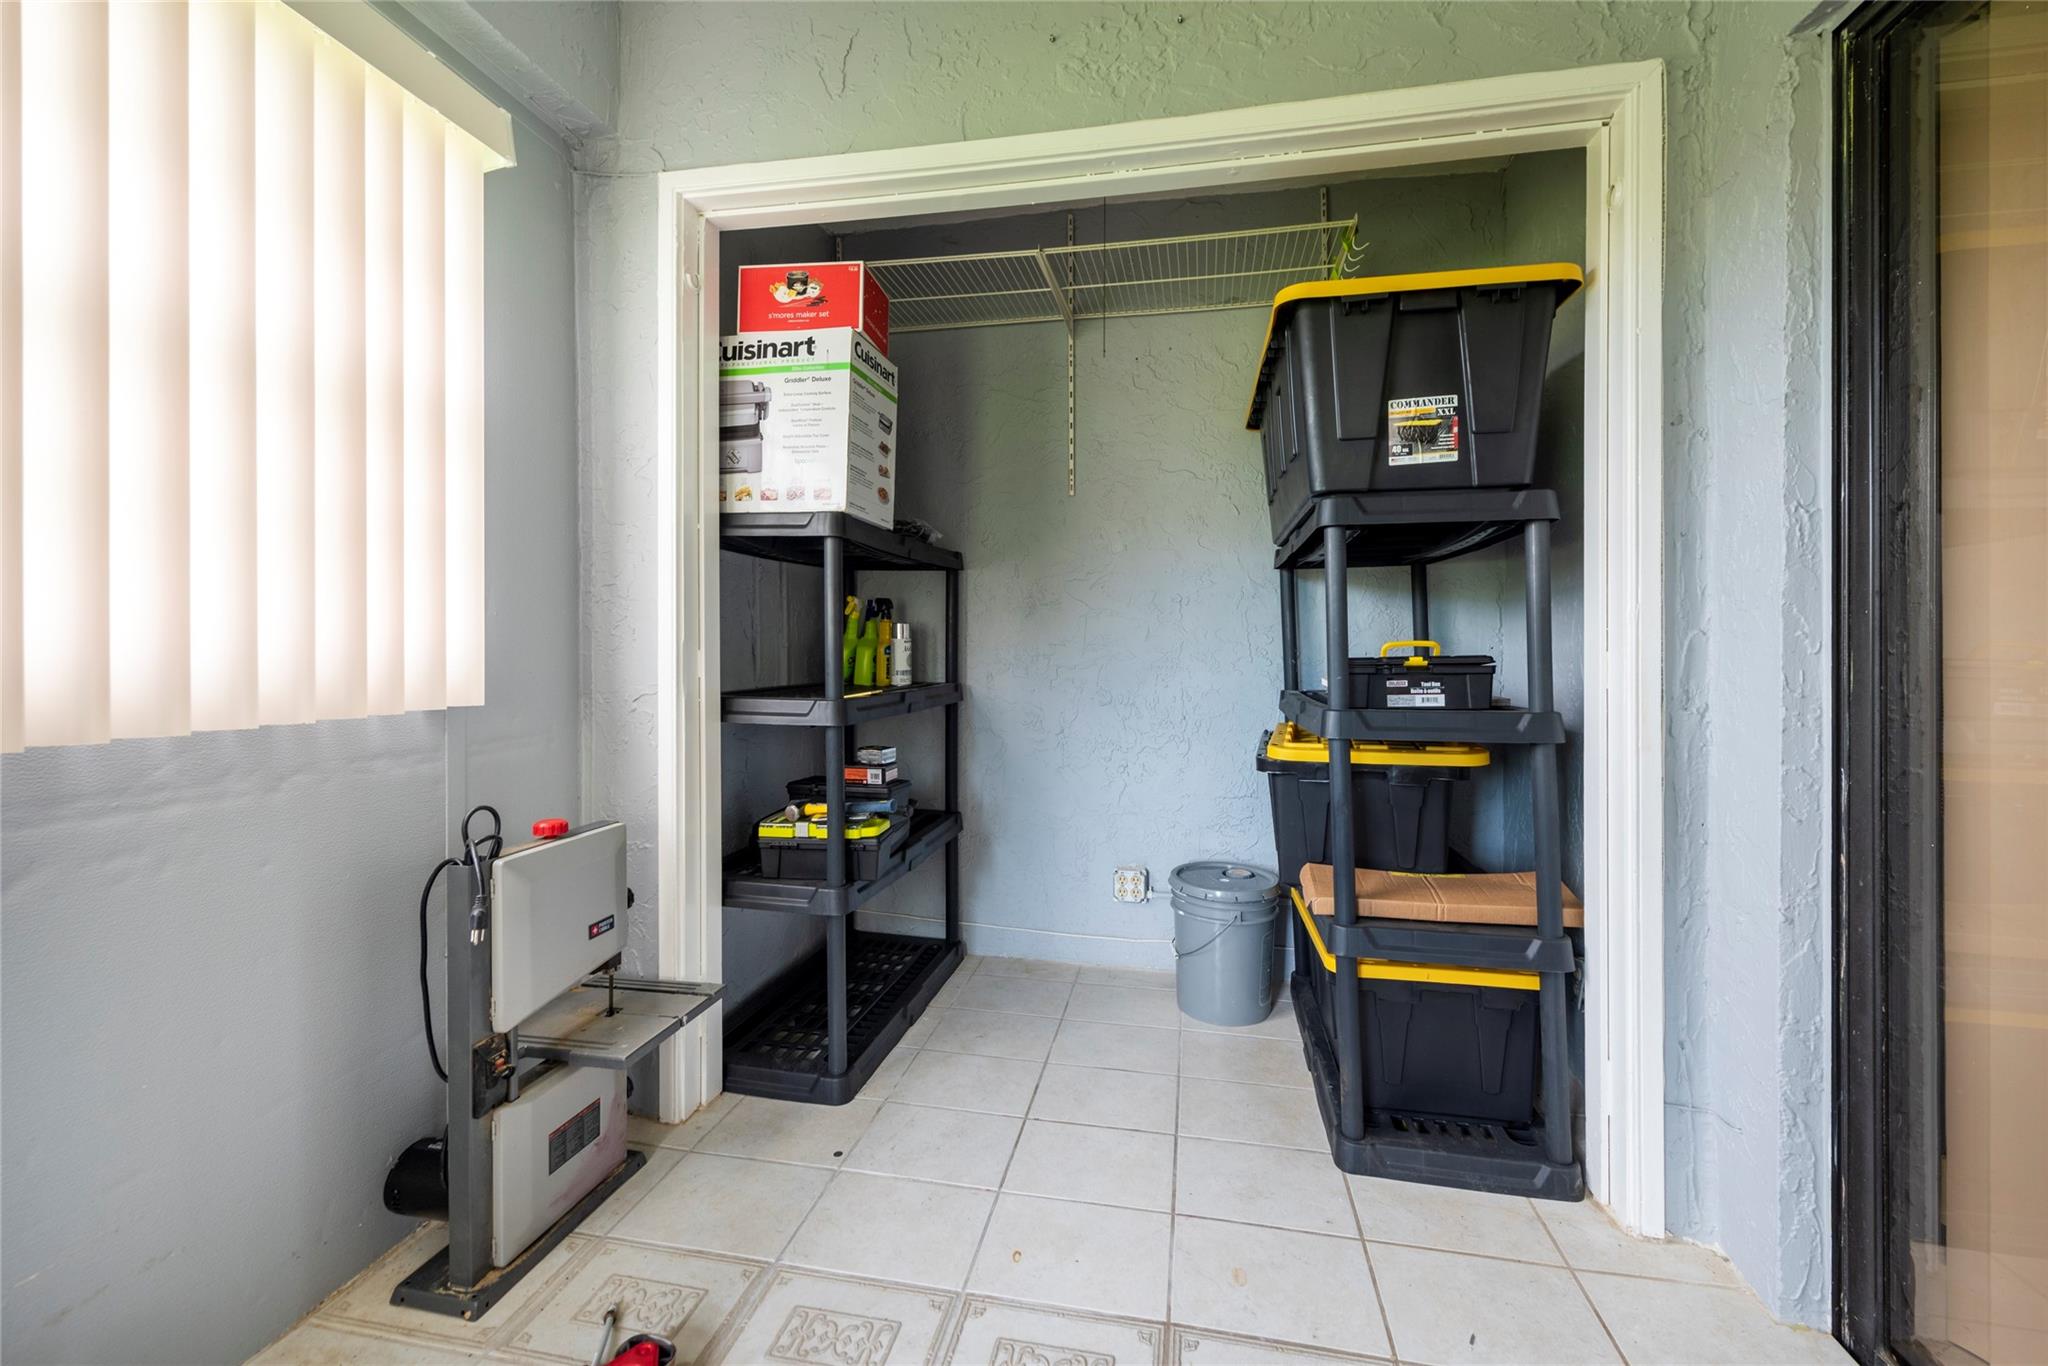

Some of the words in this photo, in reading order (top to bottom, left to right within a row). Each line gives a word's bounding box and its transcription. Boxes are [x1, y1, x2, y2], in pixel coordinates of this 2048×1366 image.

[768, 311, 794, 319] s'mores
[795, 310, 817, 318] maker
[819, 310, 830, 318] set
[719, 336, 816, 362] uisinart
[854, 341, 896, 387] Cuisinart
[1390, 396, 1455, 409] COMMANDER
[1437, 407, 1456, 416] XXL
